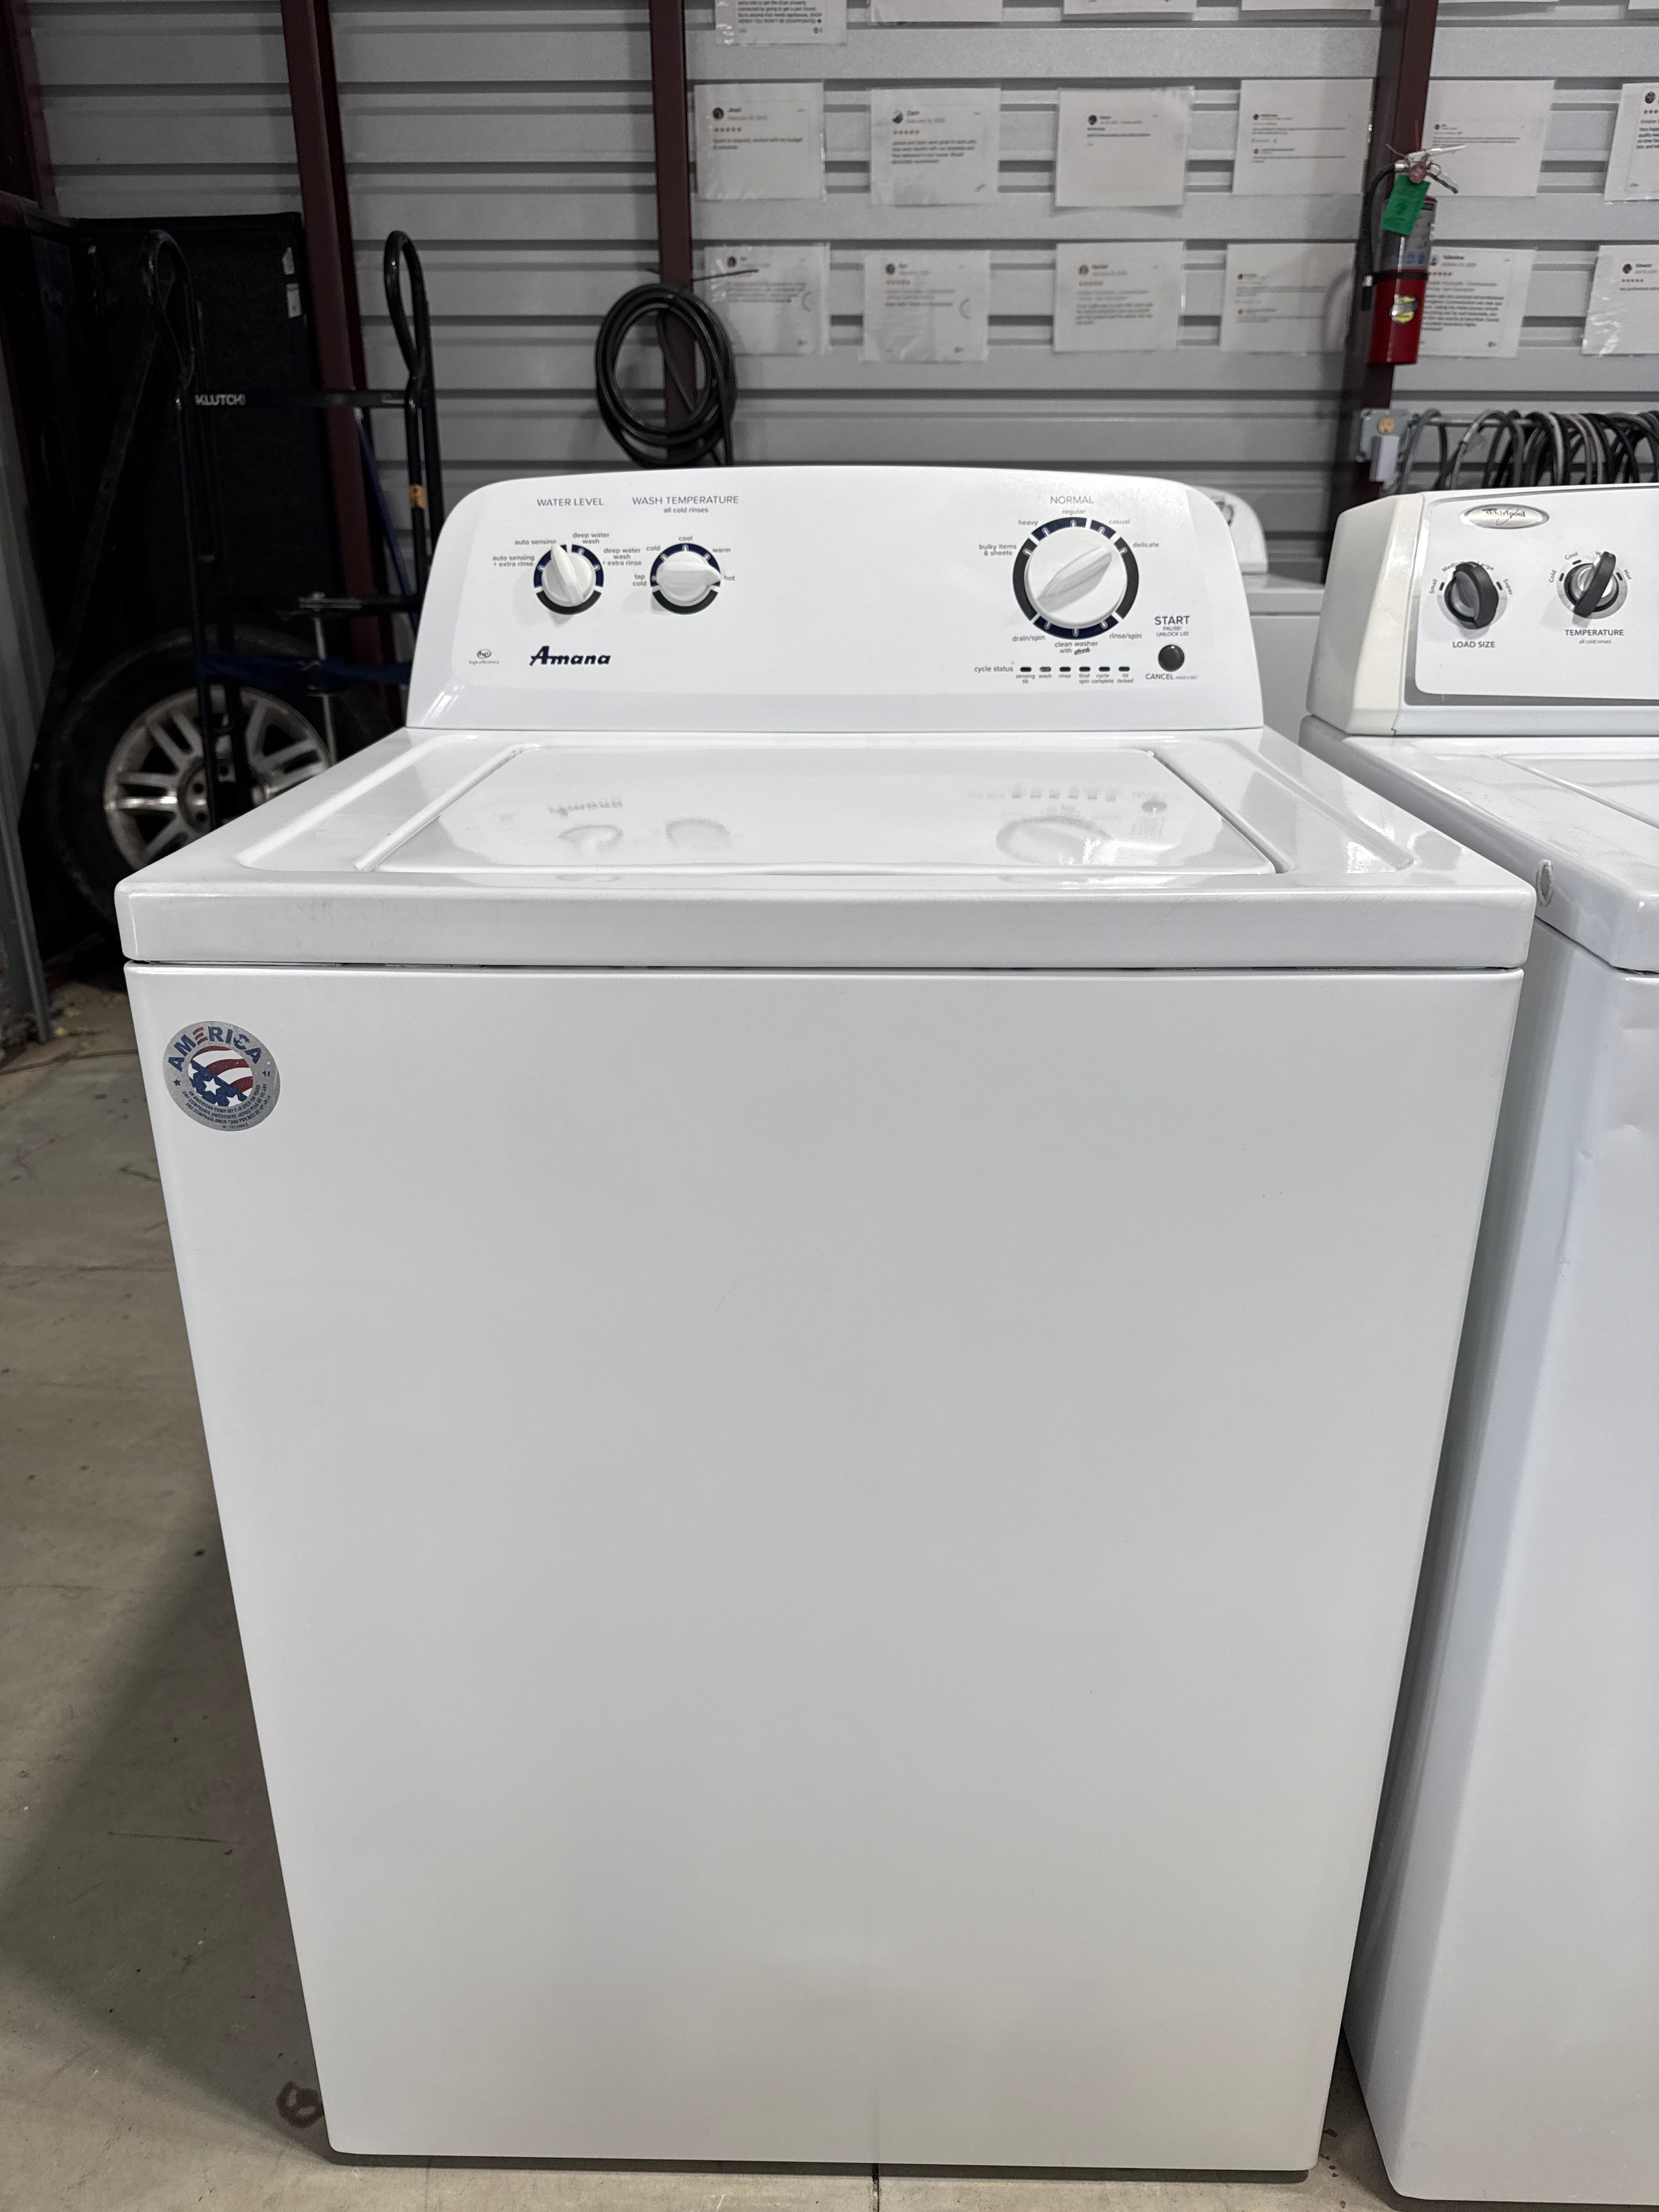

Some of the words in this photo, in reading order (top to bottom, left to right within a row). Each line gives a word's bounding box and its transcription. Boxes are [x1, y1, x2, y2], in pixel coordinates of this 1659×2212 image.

[194, 394, 246, 405] KLUTCH
[667, 496, 738, 504] TEMPERATURE
[1051, 496, 1094, 504] NORMAL
[1565, 551, 1578, 560] Cool
[1623, 569, 1632, 580] Hot
[1154, 616, 1190, 625] START
[529, 645, 611, 667] Amana
[168, 1026, 262, 1072] AMERICA
[194, 1096, 213, 1112] AMERICAN
